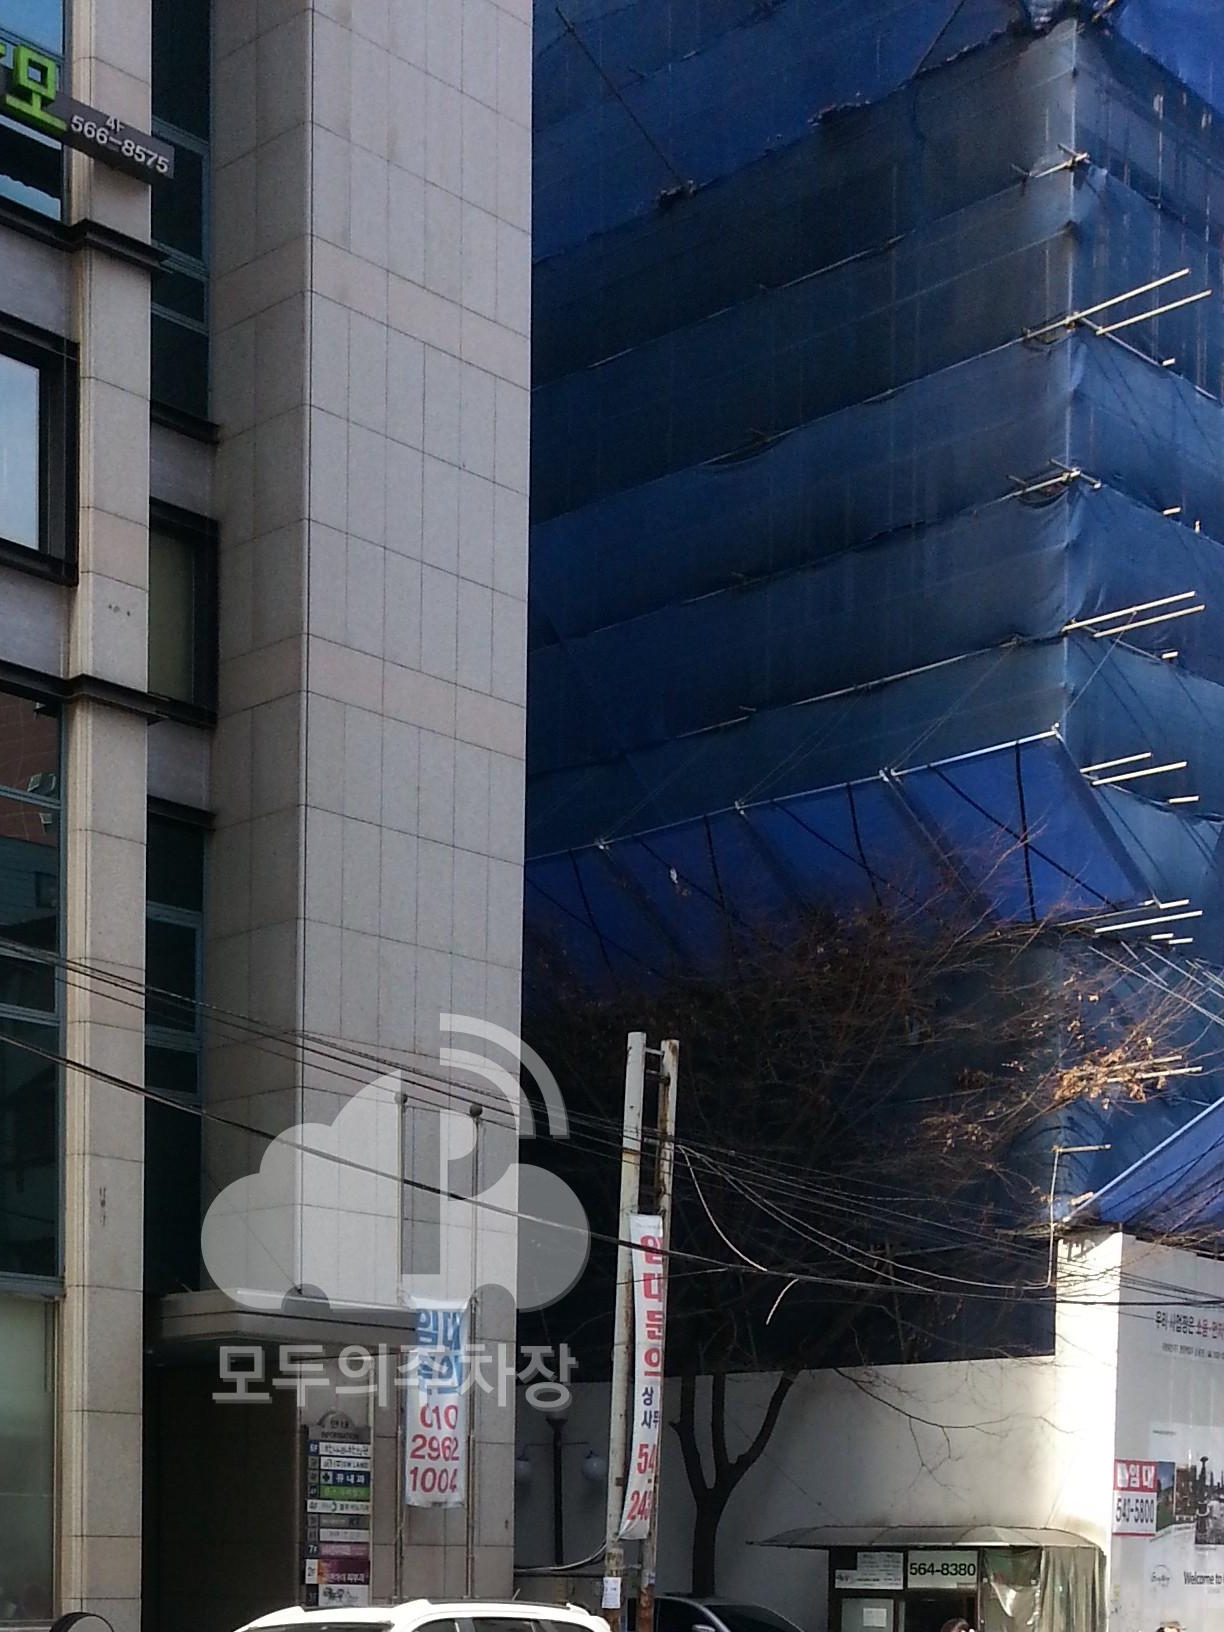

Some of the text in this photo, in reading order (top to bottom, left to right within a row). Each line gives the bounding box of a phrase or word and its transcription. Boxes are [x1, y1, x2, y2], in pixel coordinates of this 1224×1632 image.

[104, 116, 126, 135] 4F
[70, 114, 170, 174] 566-8575
[419, 1404, 459, 1431] 010
[410, 1434, 460, 1462] 2962
[409, 1466, 458, 1493] 1004
[909, 1563, 976, 1576] 564-8380
[1183, 1571, 1214, 1585] Welcome
